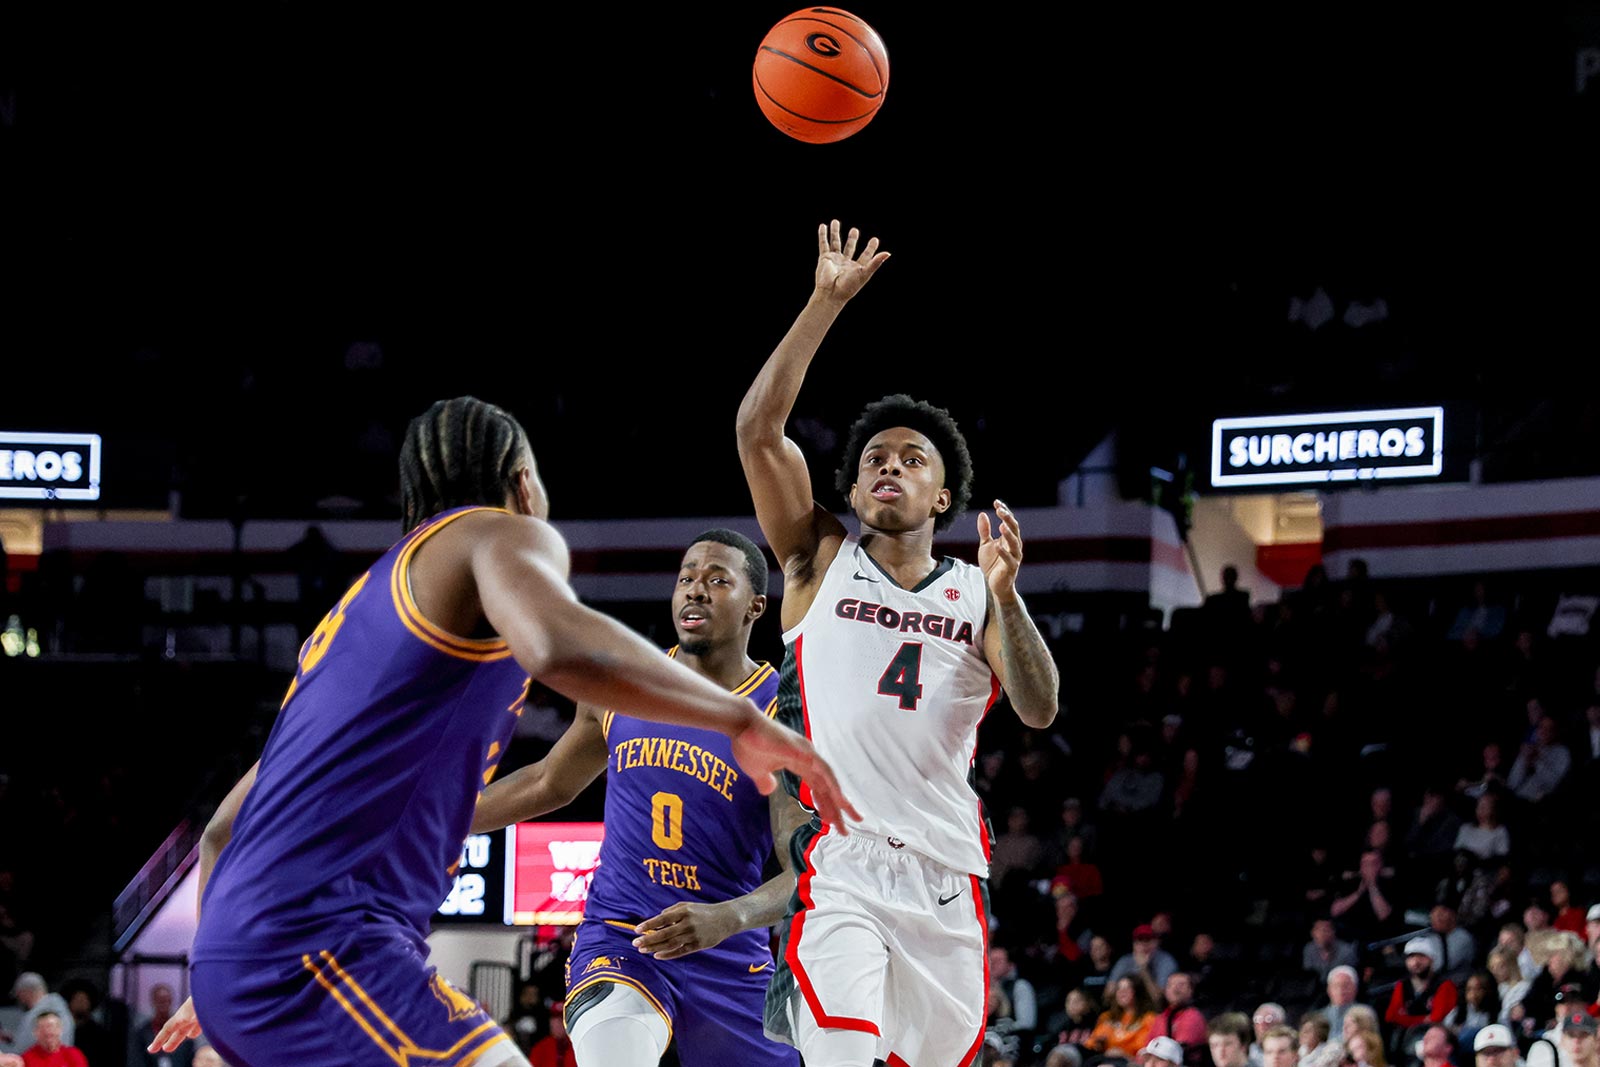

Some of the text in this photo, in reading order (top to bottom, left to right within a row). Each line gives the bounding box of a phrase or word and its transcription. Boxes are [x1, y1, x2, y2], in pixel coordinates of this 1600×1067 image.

[805, 32, 841, 57] G
[1229, 426, 1425, 467] SURCHEROS
[944, 588, 960, 601] SEC
[835, 598, 973, 646] GEORGIA
[877, 641, 923, 711] 4
[615, 737, 738, 801] TENNESSEE
[651, 791, 683, 850] 0
[643, 858, 701, 890] TECH
